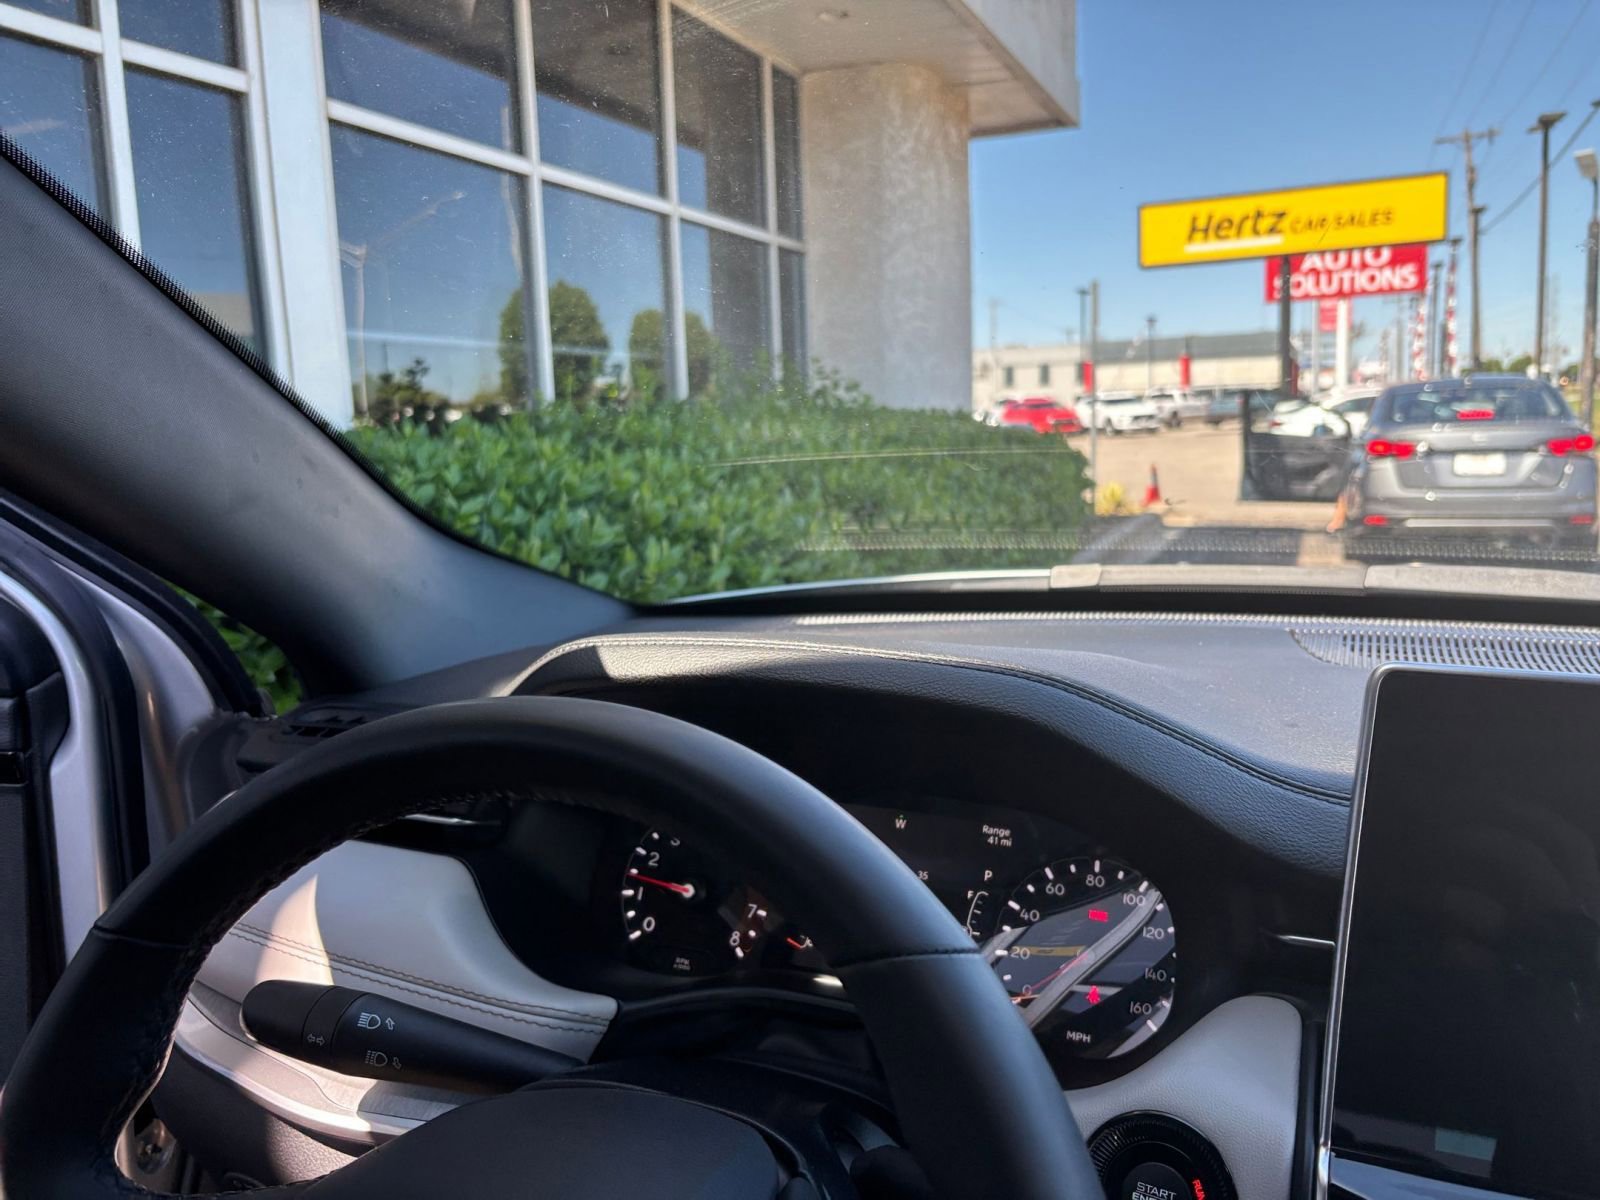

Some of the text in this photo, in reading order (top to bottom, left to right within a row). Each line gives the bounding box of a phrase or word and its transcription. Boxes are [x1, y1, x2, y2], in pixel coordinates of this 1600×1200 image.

[1186, 208, 1393, 244] Hertz CAR SALES
[895, 819, 907, 830] W
[982, 824, 1012, 838] Range
[987, 837, 1012, 847] 41 mi
[648, 851, 660, 867] 2
[984, 870, 993, 881] P
[1085, 875, 1106, 889] 80
[967, 891, 974, 899] F
[1045, 883, 1066, 896] 60
[1123, 893, 1146, 907] 100
[747, 903, 758, 919] 7
[1019, 909, 1040, 923] 40
[642, 916, 656, 932] 0
[729, 930, 741, 947] 8
[1142, 926, 1165, 941] 120
[1010, 946, 1031, 960] 20
[1145, 968, 1167, 982] 140
[1130, 1002, 1152, 1016] 160
[1066, 1030, 1092, 1044] MPH
[1137, 1181, 1176, 1200] START
